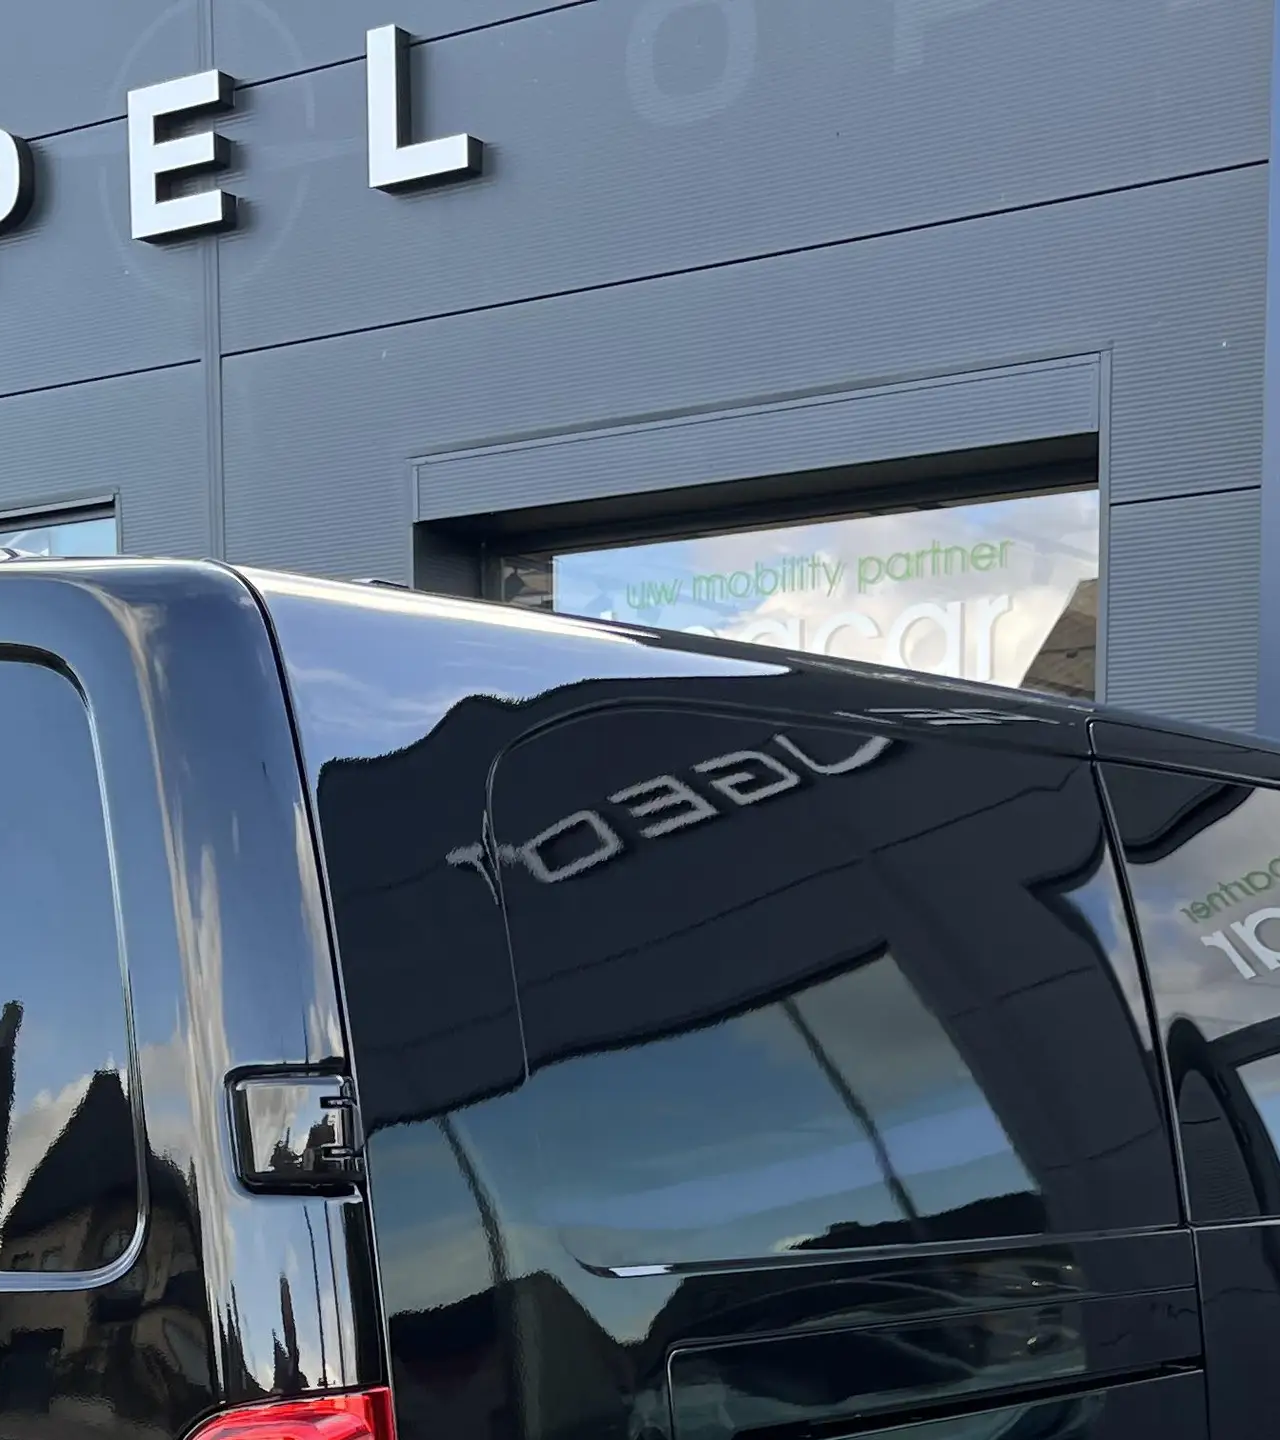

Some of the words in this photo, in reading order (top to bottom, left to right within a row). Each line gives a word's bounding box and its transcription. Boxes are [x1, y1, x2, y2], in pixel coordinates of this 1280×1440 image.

[626, 577, 683, 610] uw
[692, 553, 848, 598] mobility
[857, 538, 1013, 594] partner
